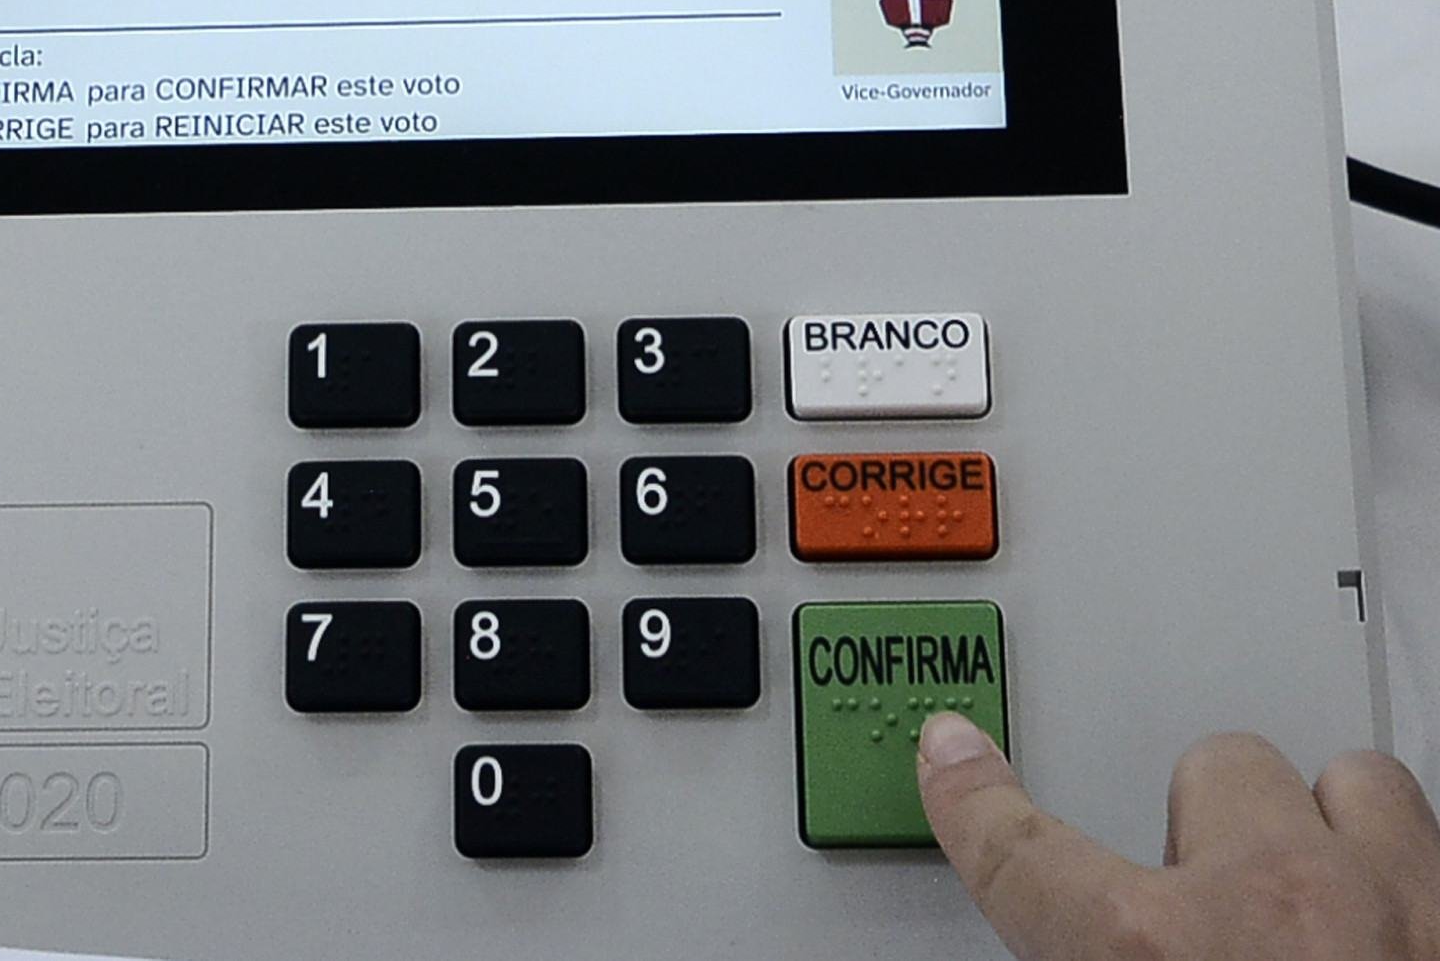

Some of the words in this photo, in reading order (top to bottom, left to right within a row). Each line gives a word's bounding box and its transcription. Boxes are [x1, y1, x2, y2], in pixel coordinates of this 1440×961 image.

[87, 84, 145, 107] para
[155, 75, 327, 101] CONFIRMAR
[337, 76, 394, 97] este
[403, 74, 461, 96] voto
[842, 82, 991, 101] Vice-Governador
[87, 120, 145, 143] para
[155, 113, 304, 137] REINICIAR
[314, 113, 371, 135] este
[380, 111, 438, 133] voto
[307, 333, 327, 378] 1
[466, 331, 499, 378] 2
[633, 328, 665, 375] 3
[803, 319, 971, 352] BRANCO
[300, 471, 334, 519] 4
[469, 471, 502, 519] 5
[636, 468, 668, 516] 6
[801, 460, 985, 492] CORRIGE
[300, 614, 333, 661] 7
[469, 612, 501, 660] 8
[638, 610, 671, 658] 9
[808, 635, 995, 686] CONFIRMA
[470, 757, 503, 806] 0
